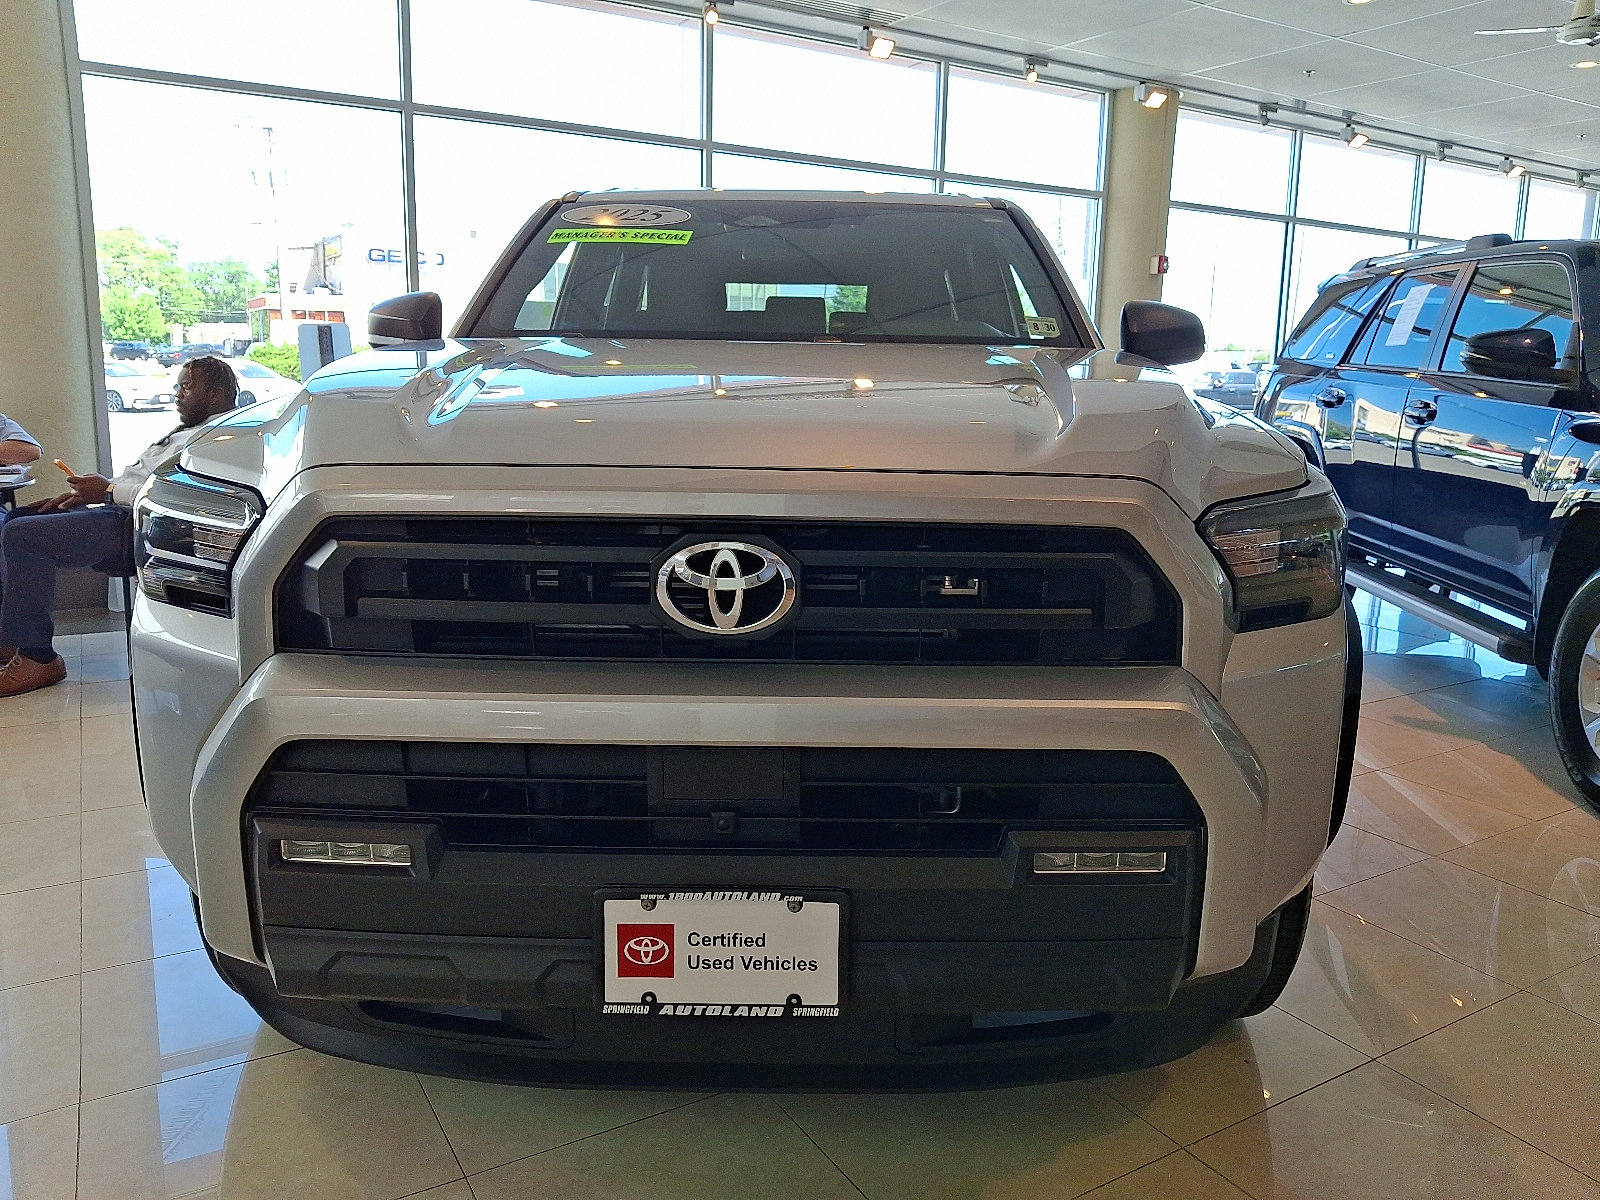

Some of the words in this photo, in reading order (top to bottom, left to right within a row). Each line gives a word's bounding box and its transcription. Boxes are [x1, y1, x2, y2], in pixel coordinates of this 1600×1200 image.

[580, 207, 672, 222] 2025
[552, 230, 628, 240] MANAGER'S
[631, 231, 687, 240] SPECIAL
[368, 248, 445, 265] GEC
[1032, 322, 1039, 331] 8
[1044, 323, 1056, 332] 30
[687, 931, 767, 948] Certified
[687, 954, 735, 970] Used
[740, 955, 819, 971] Vehicles
[602, 1004, 650, 1015] SPRINGFIELD
[658, 1004, 786, 1017] AUTOLAND
[792, 1006, 840, 1017] SPRINGFIELD
